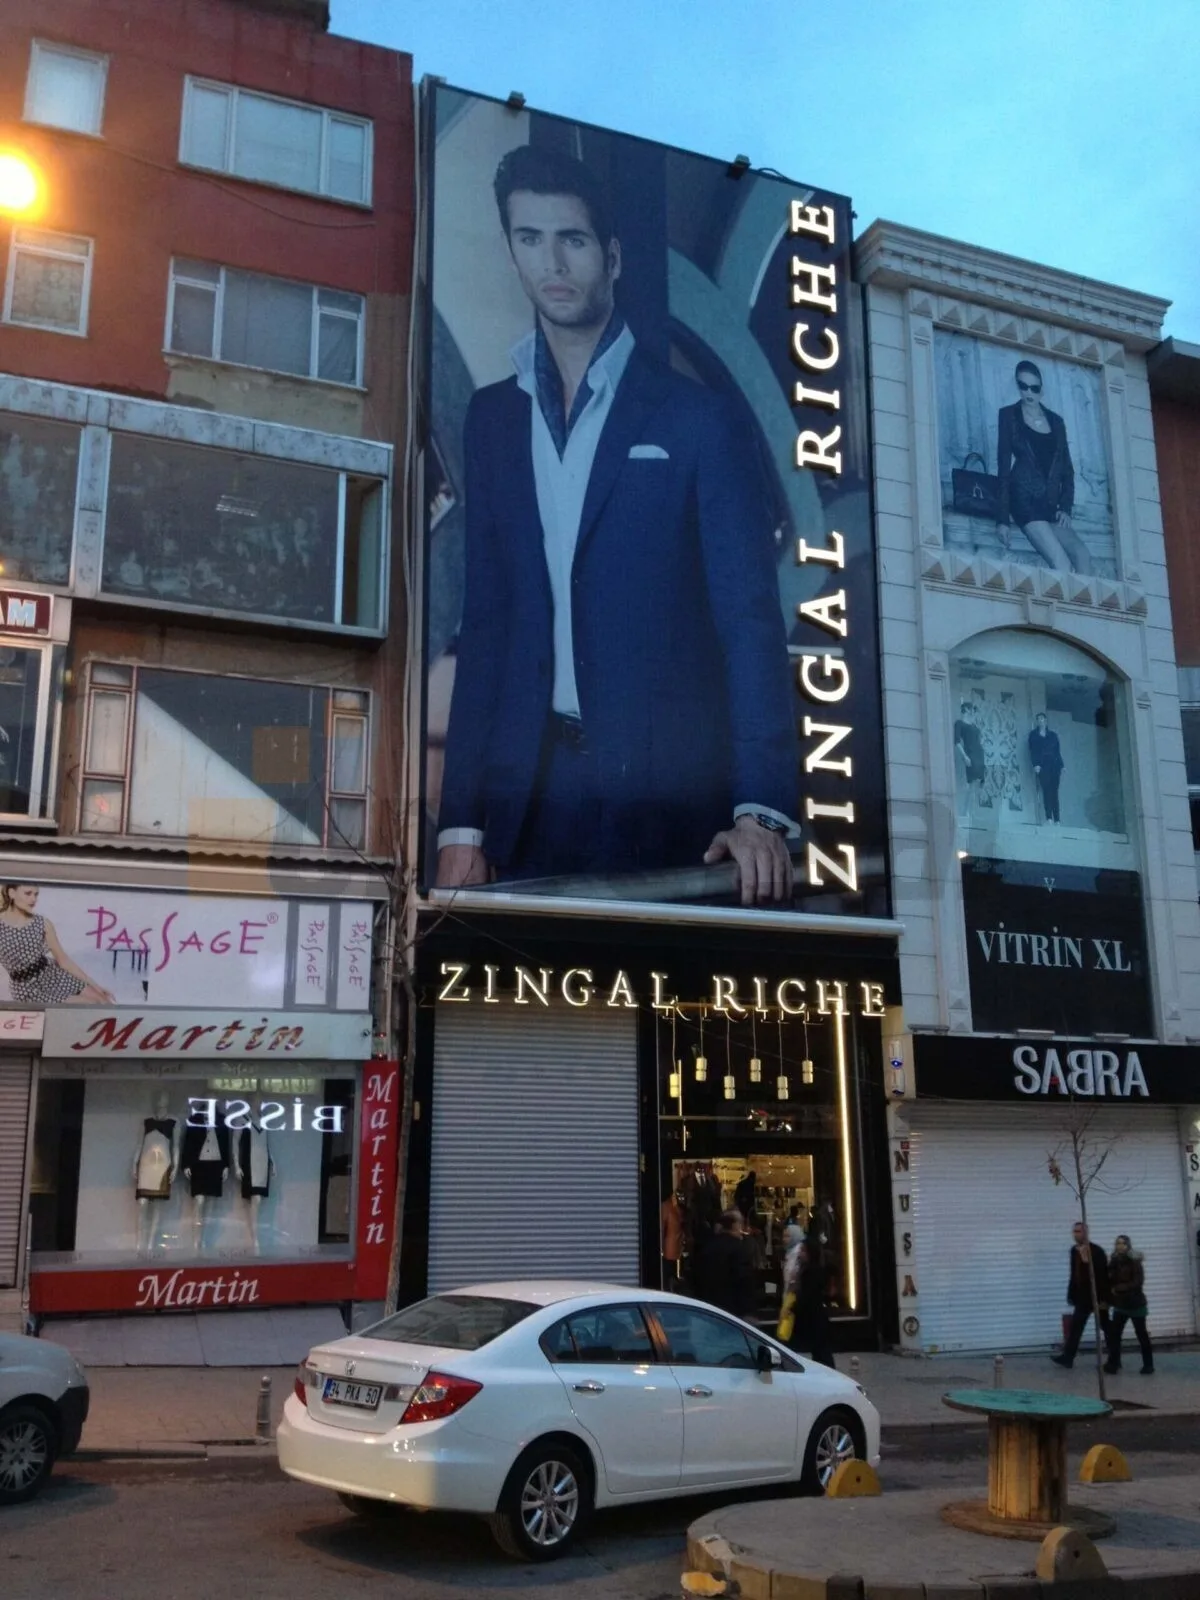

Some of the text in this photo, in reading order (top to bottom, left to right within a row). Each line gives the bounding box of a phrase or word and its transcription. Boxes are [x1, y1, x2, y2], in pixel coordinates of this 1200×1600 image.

[791, 199, 858, 892] ZINGAL RICHE
[0, 595, 37, 628] M
[85, 906, 268, 972] PASSAGE
[1092, 938, 1132, 972] XL
[439, 962, 887, 1017] ZINGAL RICHE
[71, 1016, 303, 1052] Martin
[1012, 1045, 1151, 1097] SABRA
[366, 1071, 397, 1245] Martin
[135, 1268, 260, 1307] Martin
